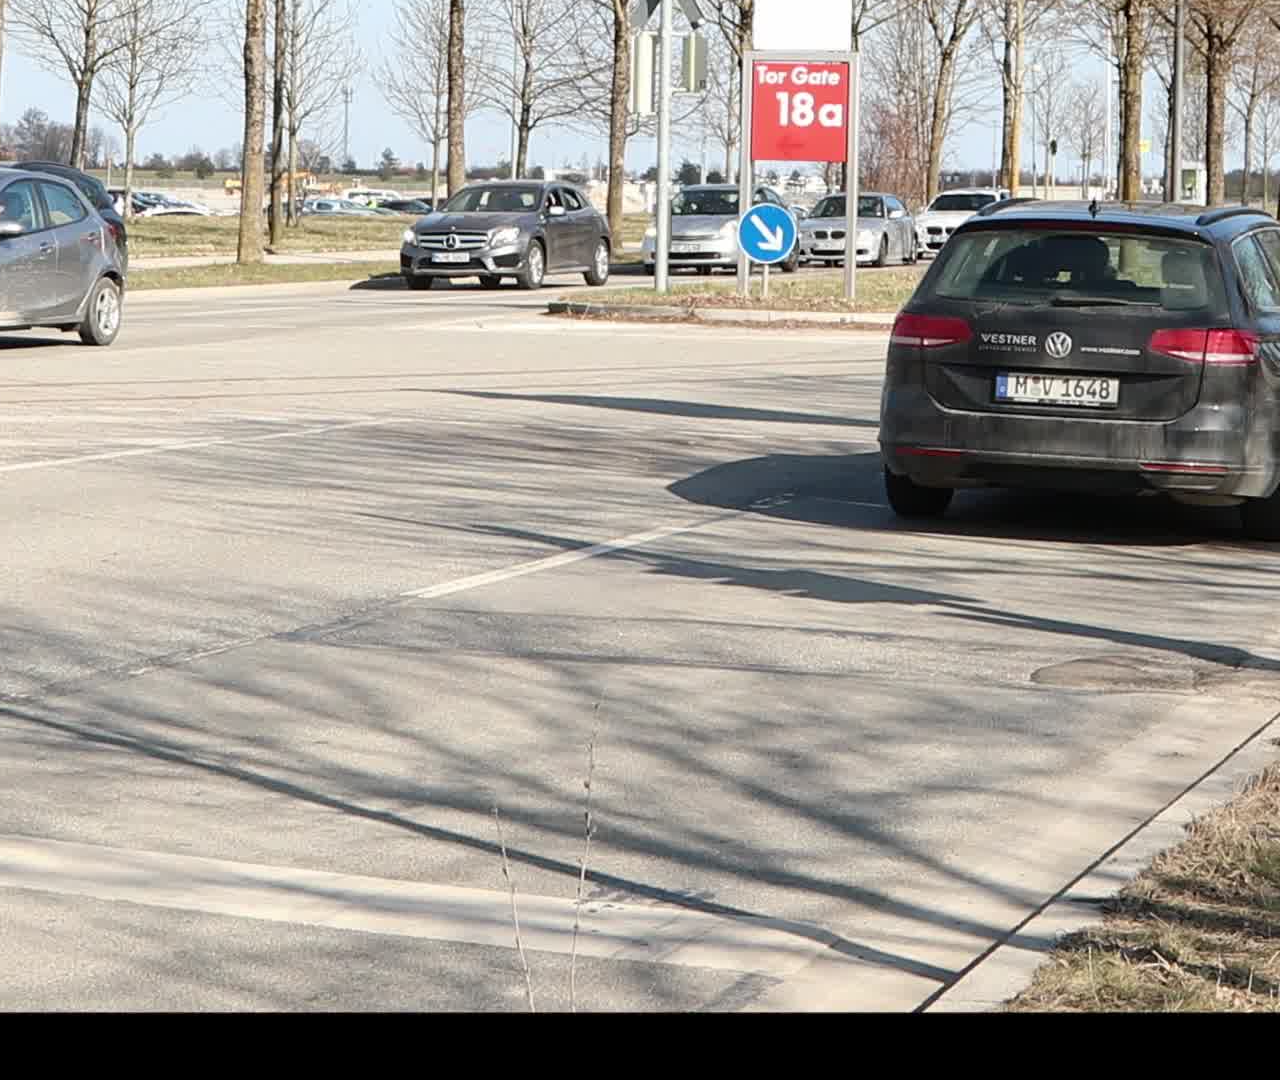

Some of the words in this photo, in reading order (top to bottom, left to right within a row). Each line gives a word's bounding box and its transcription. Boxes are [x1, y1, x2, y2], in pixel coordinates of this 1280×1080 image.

[757, 66, 787, 85] Tor
[791, 66, 840, 85] Gate
[775, 91, 843, 127] 18a
[980, 332, 1037, 346] VESTNER
[1015, 375, 1029, 395] M
[1041, 377, 1054, 396] V
[1061, 378, 1111, 400] 1648
